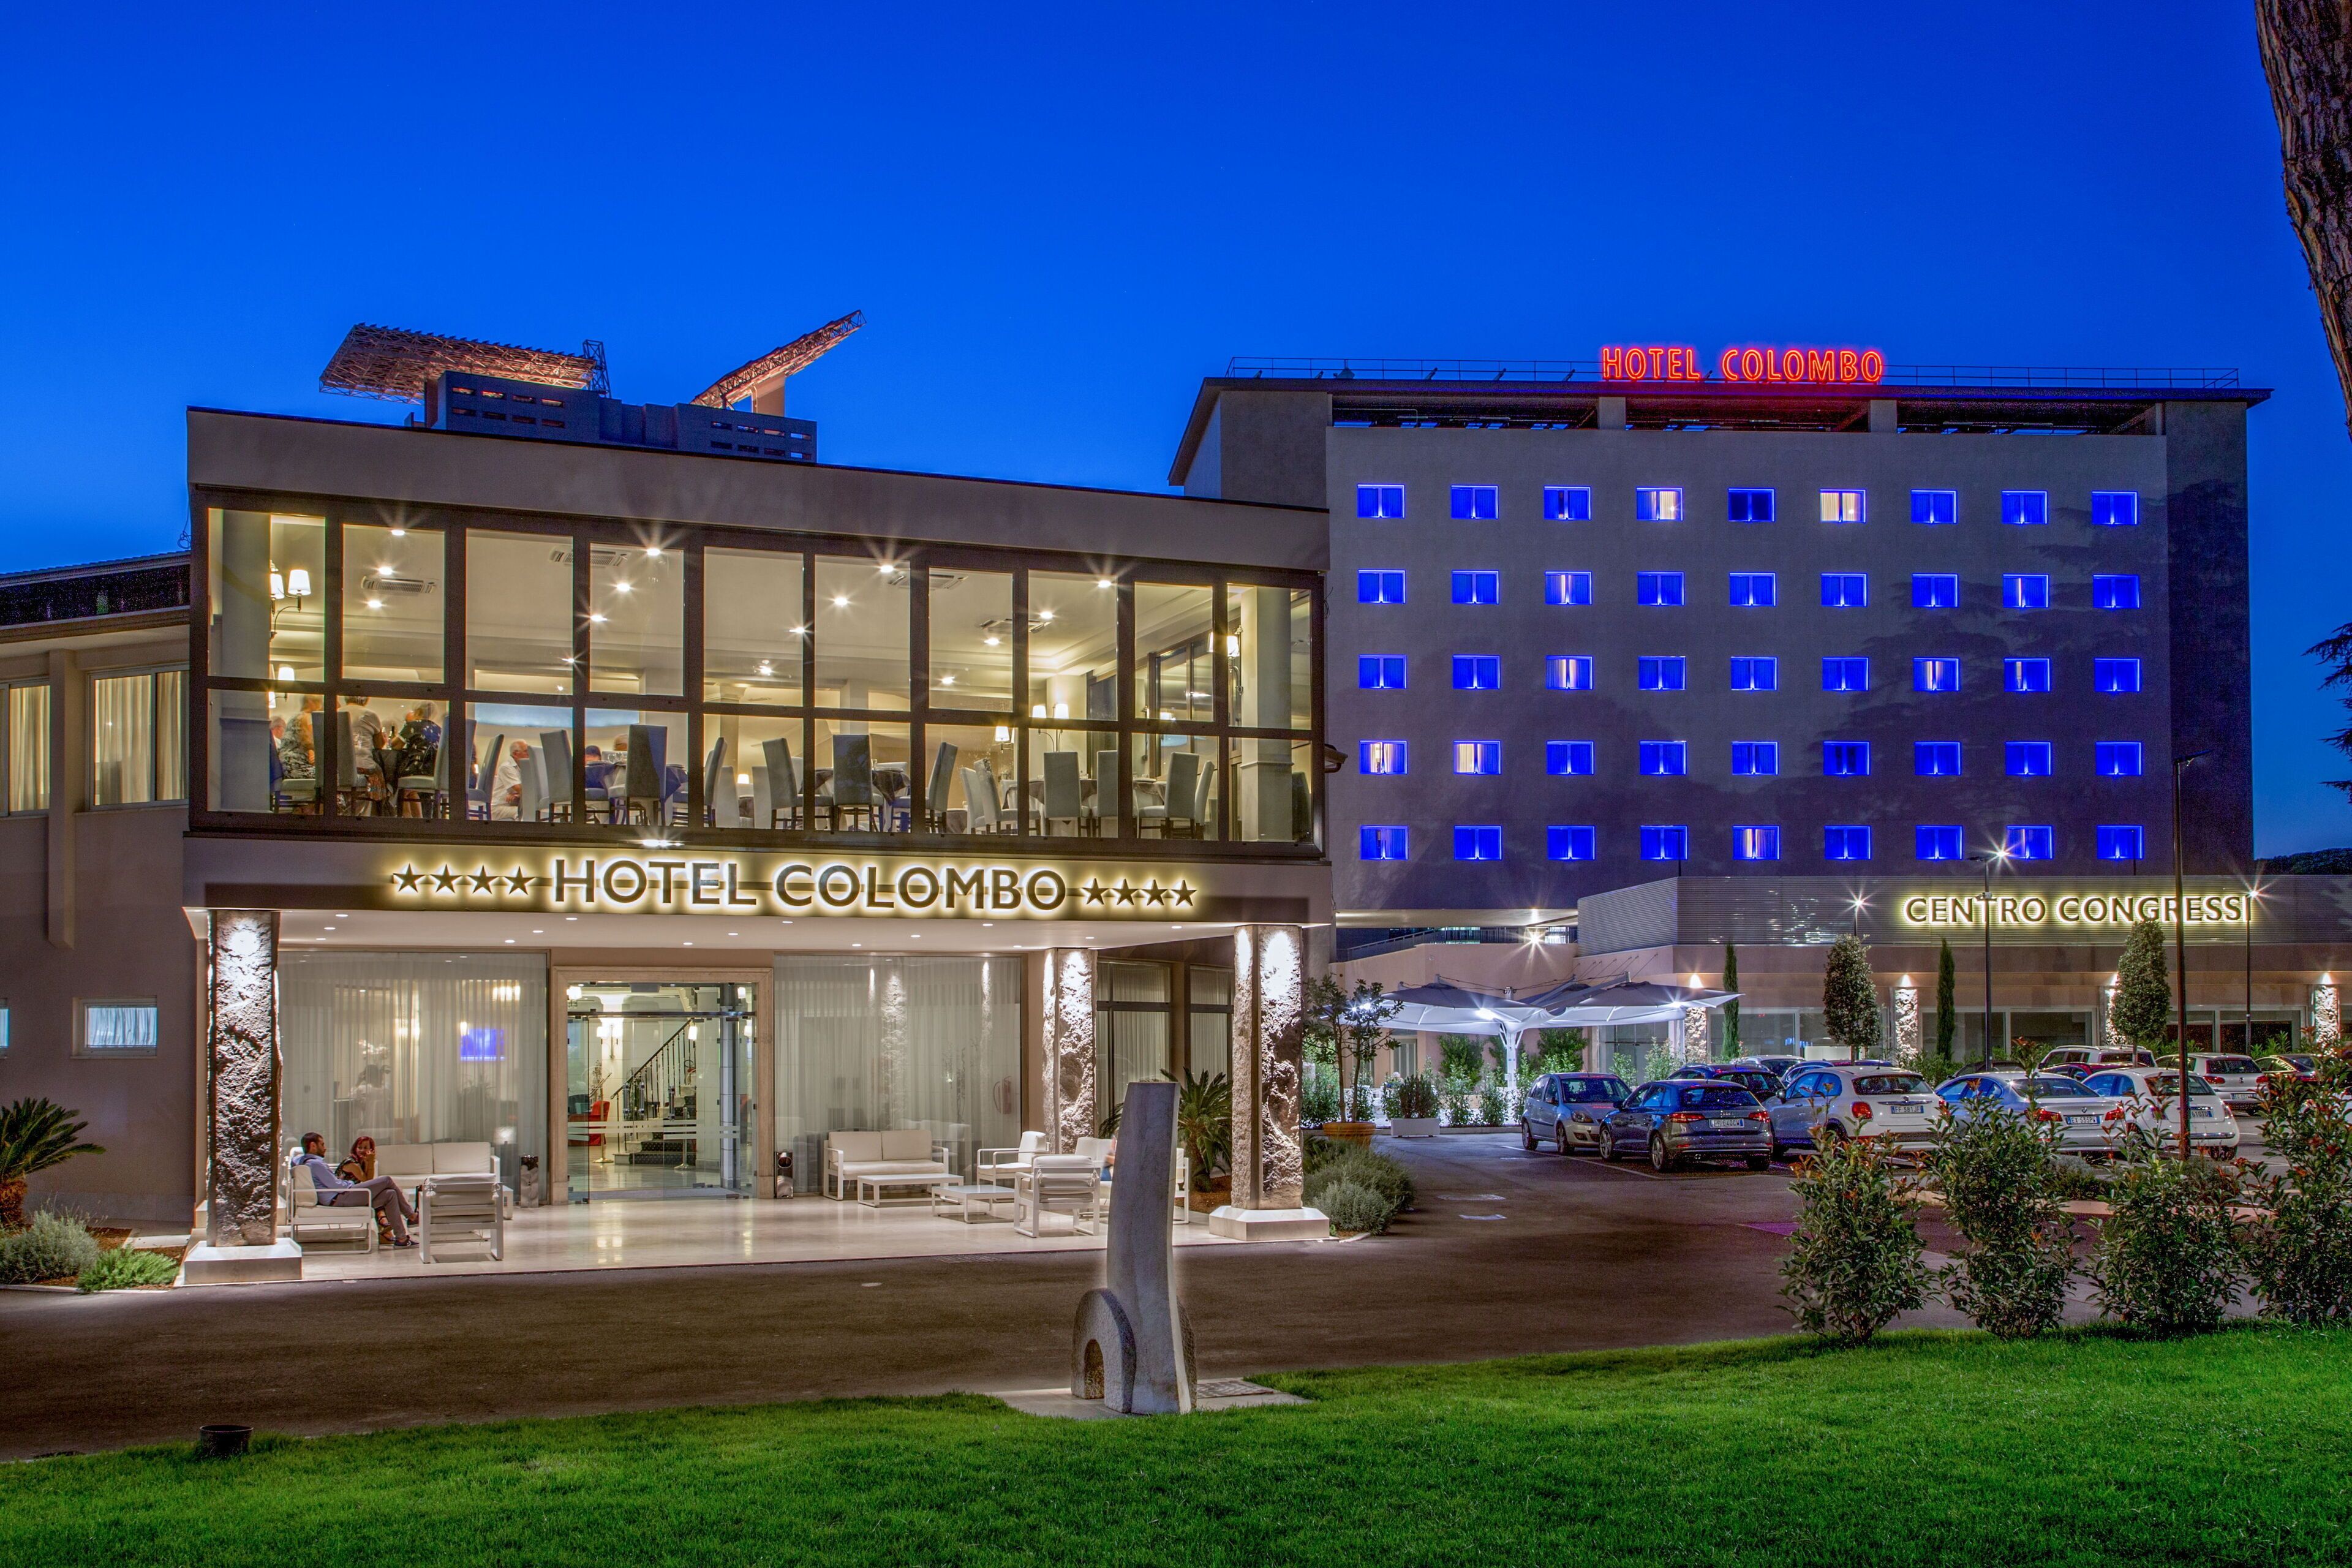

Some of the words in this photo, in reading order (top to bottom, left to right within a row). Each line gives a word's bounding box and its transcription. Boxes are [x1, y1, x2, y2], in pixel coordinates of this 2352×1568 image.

[1602, 347, 1701, 380] HOTEL
[1721, 349, 1883, 382] COLOMBO
[552, 859, 757, 905] HOTEL
[774, 863, 1067, 910] COLOMBO
[1905, 897, 2046, 922] CENTRO
[2058, 895, 2252, 922] CONGRESSI
